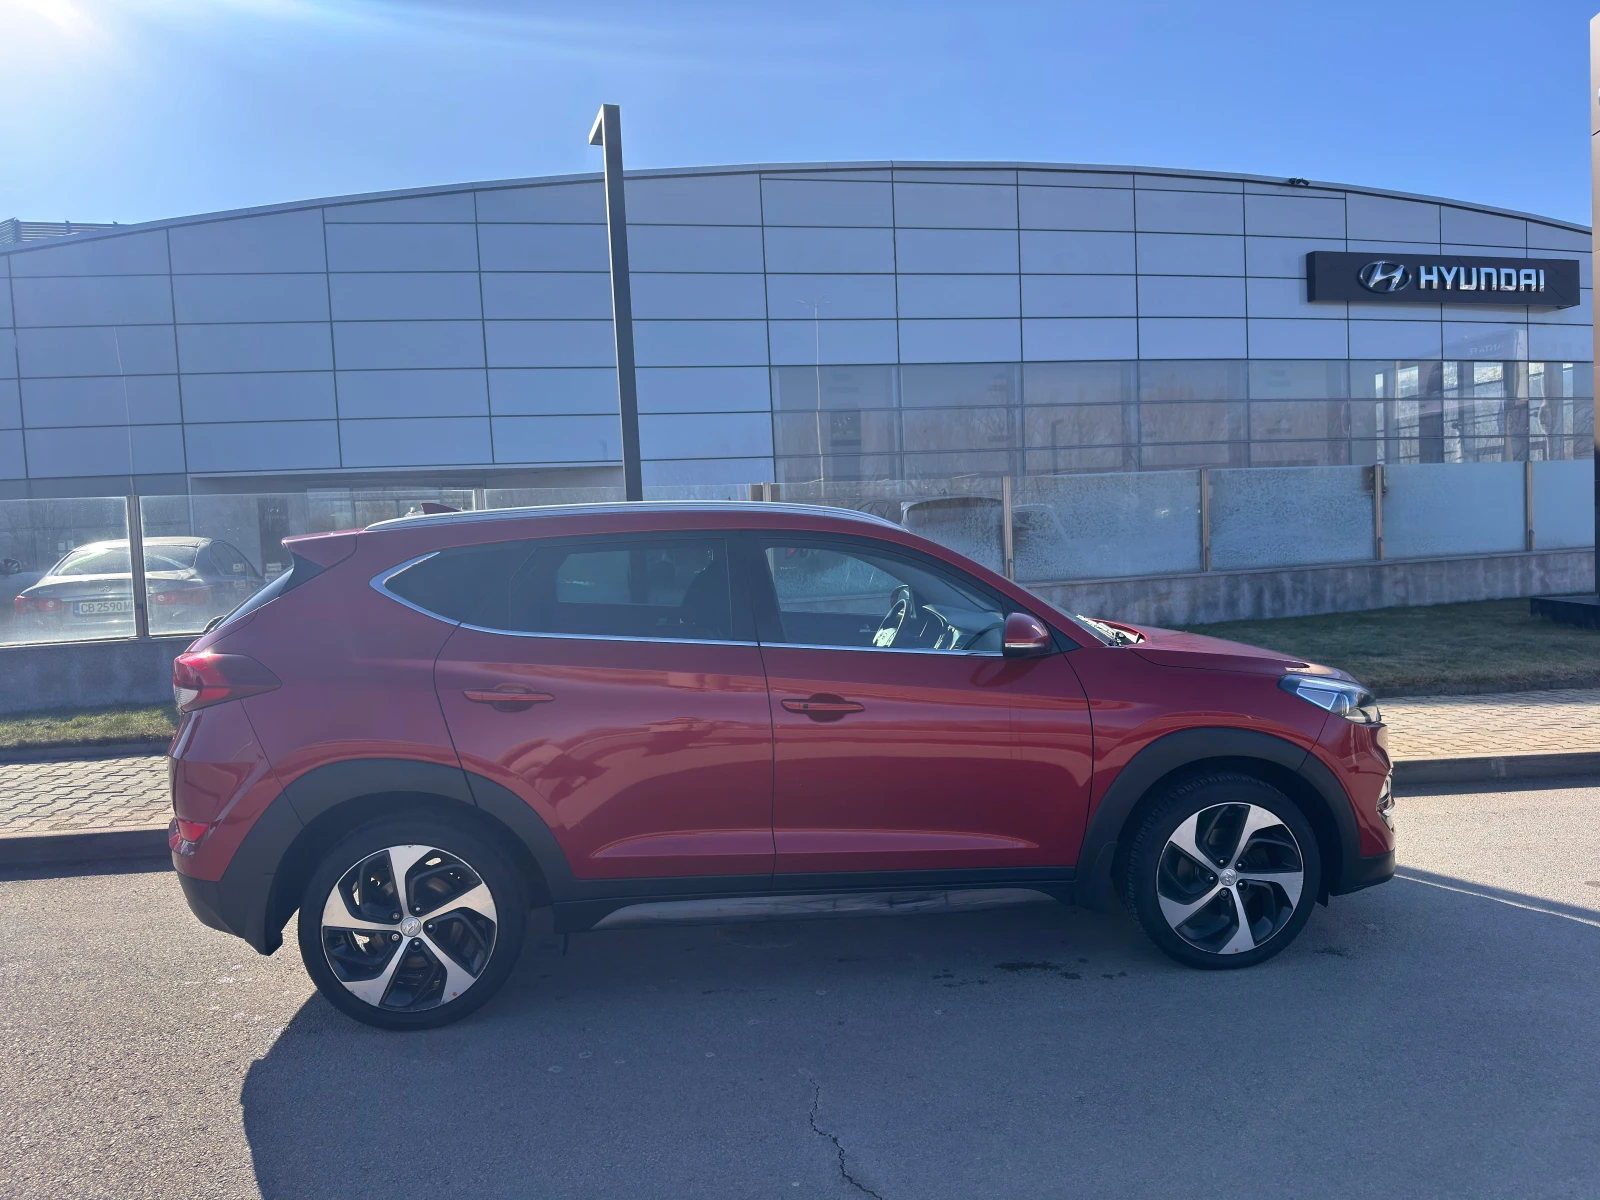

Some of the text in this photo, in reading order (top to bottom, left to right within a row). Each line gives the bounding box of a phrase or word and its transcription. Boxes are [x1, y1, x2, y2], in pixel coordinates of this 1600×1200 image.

[1419, 265, 1545, 292] HYUNDAI
[81, 603, 95, 613] CB
[97, 602, 122, 612] 2590
